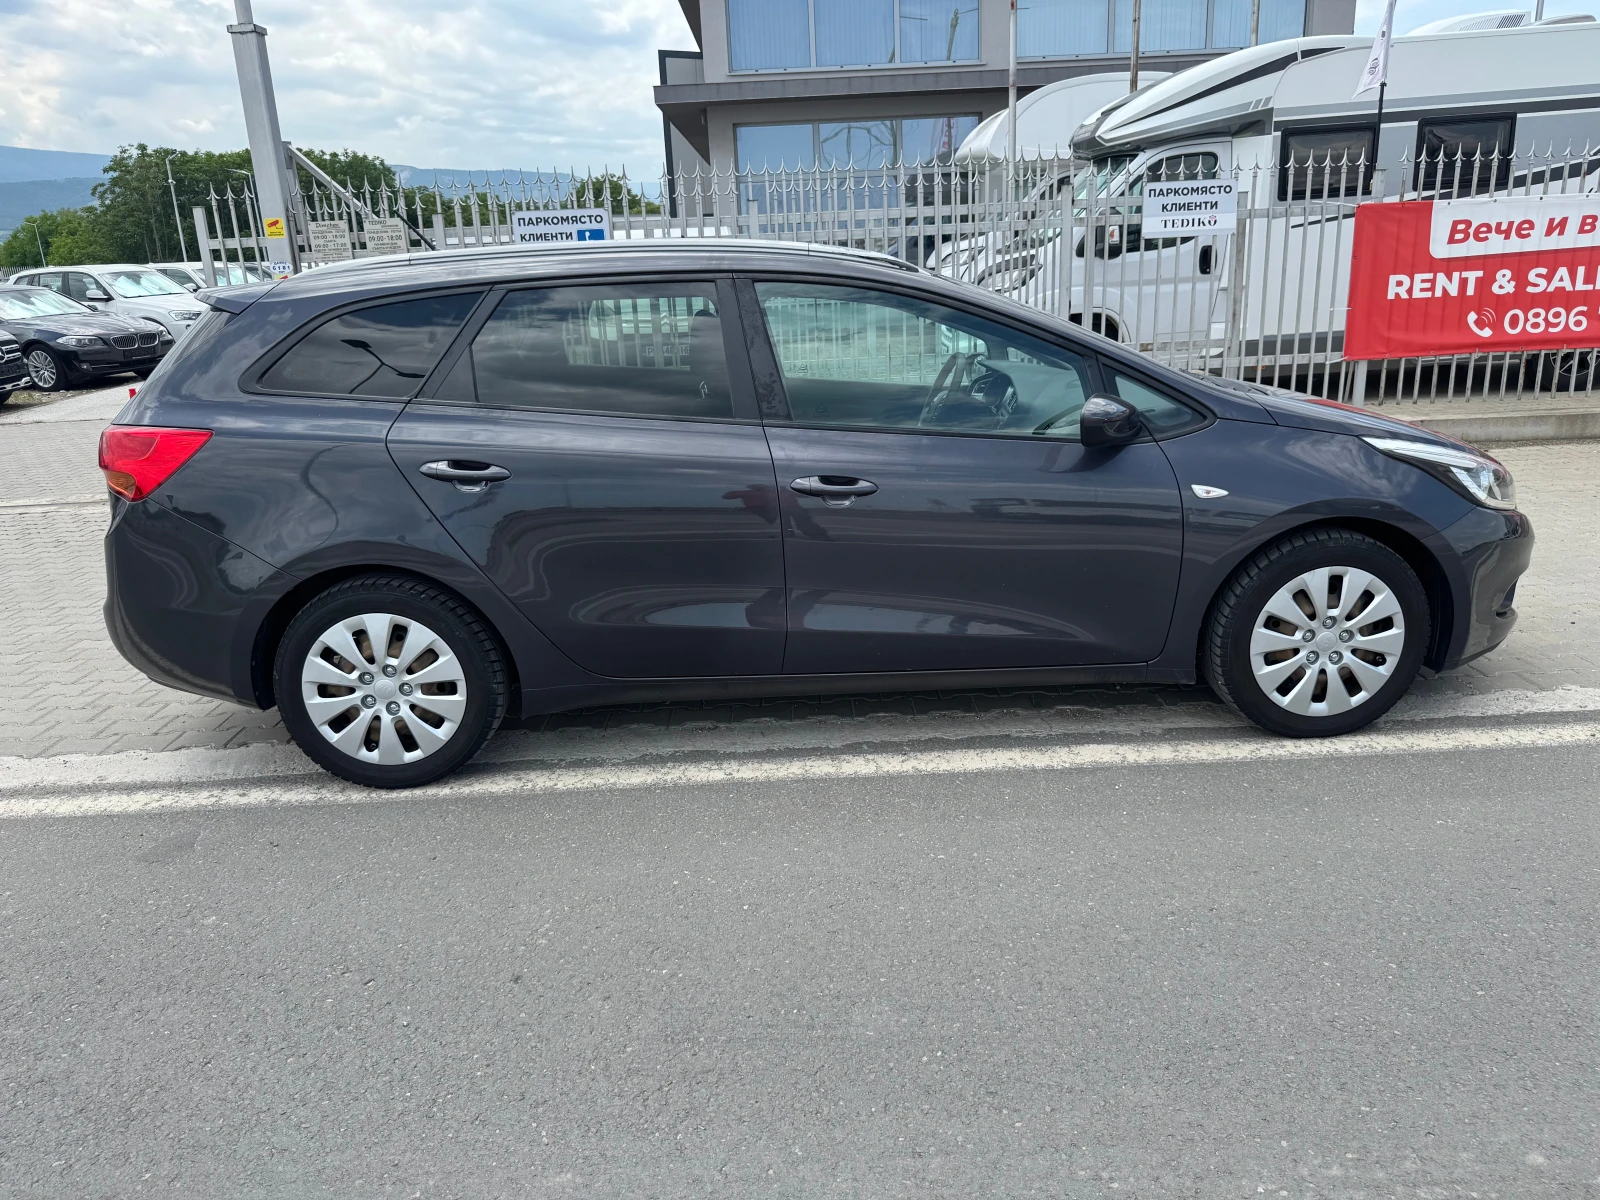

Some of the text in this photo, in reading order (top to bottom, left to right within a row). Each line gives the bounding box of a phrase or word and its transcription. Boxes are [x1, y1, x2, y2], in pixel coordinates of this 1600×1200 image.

[1148, 184, 1233, 198] ПАРКОМЯСТО
[1161, 200, 1219, 213] КЛИЕНТИ
[517, 214, 604, 227] ПАРКОМЯСТО
[1161, 215, 1217, 229] TEDIKO
[520, 231, 574, 242] КЛИЕНТИ
[1446, 218, 1536, 245] Вече
[1544, 216, 1569, 238] и
[1387, 265, 1600, 300] RENT & SAL
[1503, 305, 1588, 335] 0896
